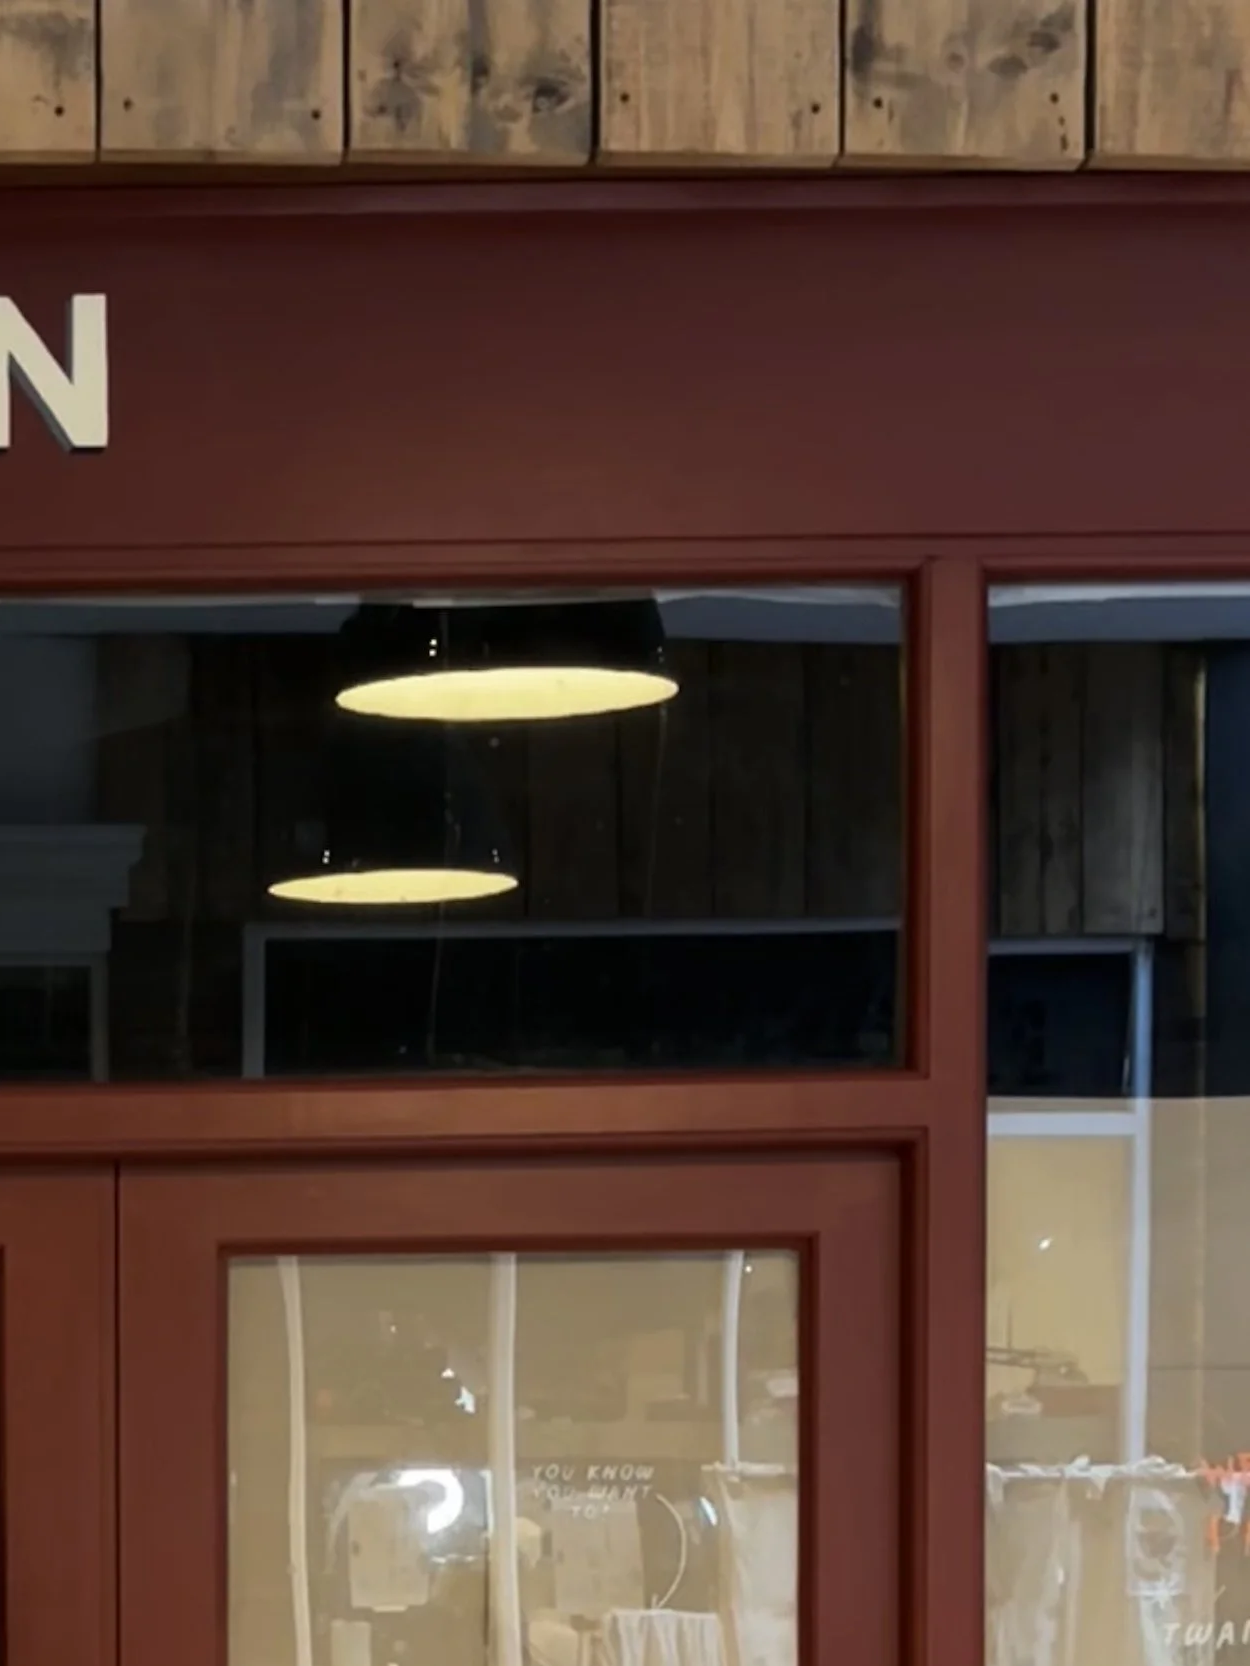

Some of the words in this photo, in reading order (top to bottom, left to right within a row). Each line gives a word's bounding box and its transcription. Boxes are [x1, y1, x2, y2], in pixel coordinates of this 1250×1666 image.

[532, 1463, 575, 1481] YOU
[587, 1463, 655, 1481] KNOW
[533, 1483, 575, 1500] YOU
[587, 1484, 652, 1500] WANT
